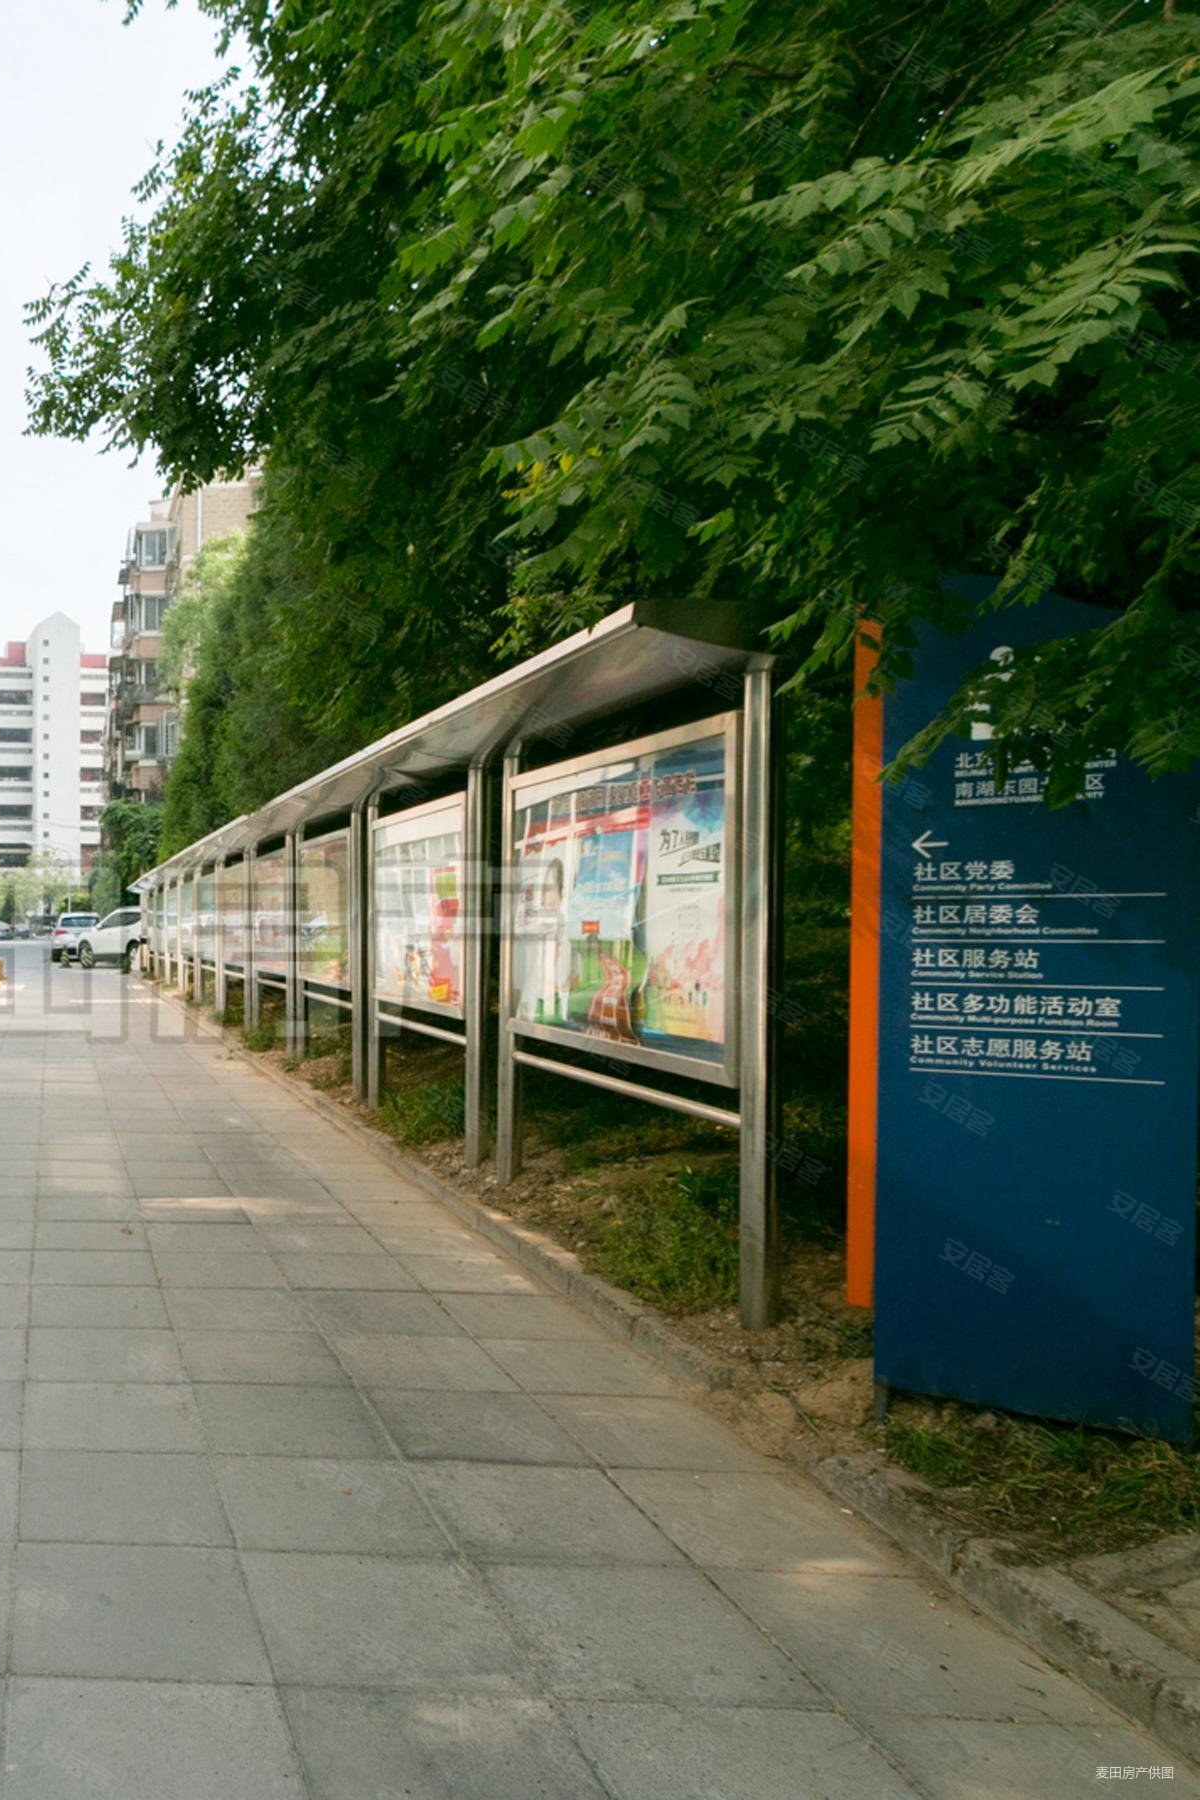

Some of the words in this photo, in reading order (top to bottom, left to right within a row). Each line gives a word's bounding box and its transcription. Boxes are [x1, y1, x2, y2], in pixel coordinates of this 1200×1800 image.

[913, 860, 1015, 881] 社区党委
[912, 884, 966, 893] Community
[969, 883, 995, 892] Party
[998, 882, 1054, 891] Committee
[912, 903, 1039, 925] 社区居委会
[912, 926, 966, 936] Community
[969, 927, 1040, 937] Neighborhood
[1042, 926, 1099, 936] Committee
[911, 948, 1040, 968] 社区服务站
[910, 970, 965, 980] Community
[968, 971, 1005, 979] Service
[1007, 972, 1044, 980] Station
[910, 991, 1122, 1017] 社区多功能活动室
[910, 1013, 964, 1023] Community
[967, 1015, 1036, 1025] Multi-purpose
[1037, 1018, 1084, 1027] Function
[1086, 1019, 1120, 1028] Room
[911, 1034, 1093, 1062] 社区志愿服务站
[909, 1056, 975, 1067] Community
[978, 1059, 1037, 1070] Volunteer
[1040, 1062, 1097, 1073] Services
